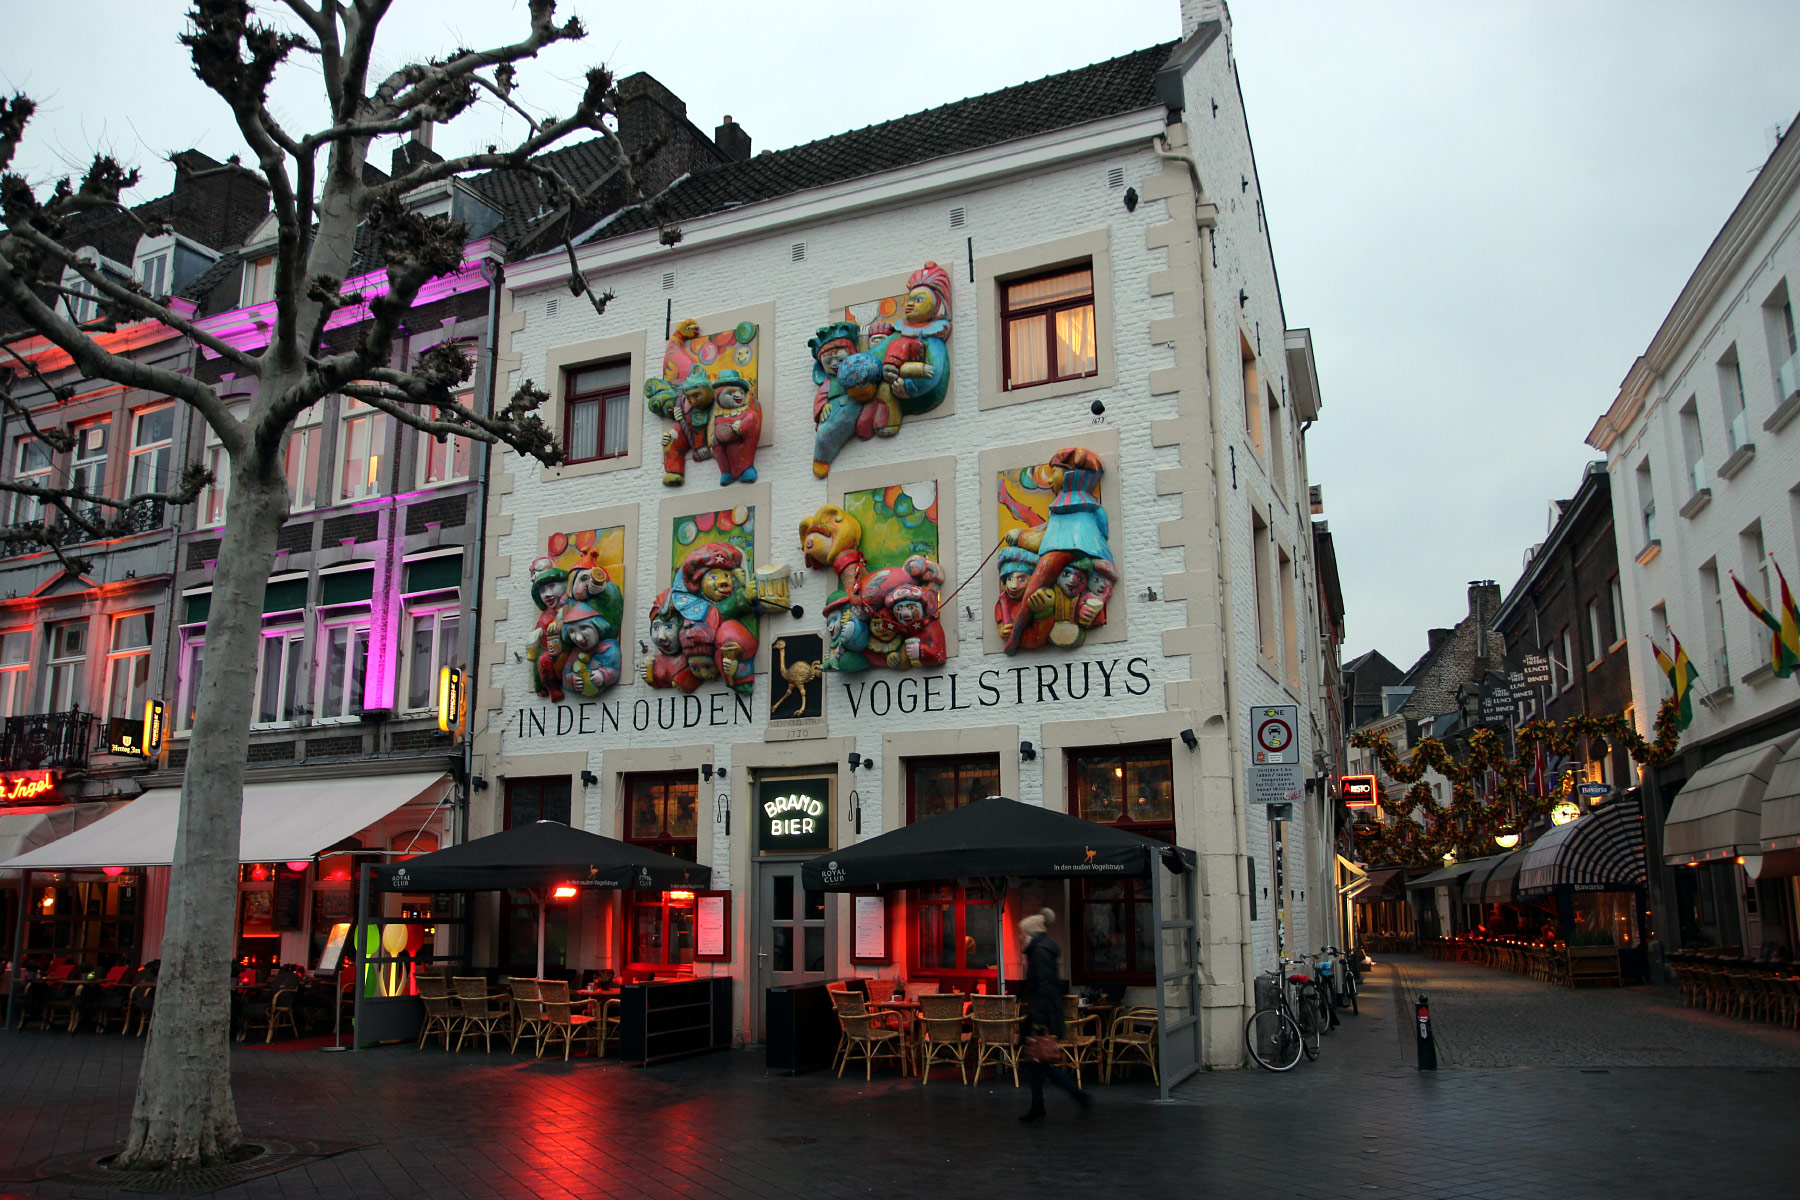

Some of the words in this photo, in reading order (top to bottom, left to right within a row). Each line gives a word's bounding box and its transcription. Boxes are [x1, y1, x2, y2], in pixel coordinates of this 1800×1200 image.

[1524, 665, 1549, 673] LUNCH
[1527, 675, 1549, 683] DINER
[843, 658, 1151, 718] VOGELSTRUYS
[1513, 690, 1533, 698] DINER
[518, 706, 546, 738] IN
[556, 701, 619, 736] DEN
[633, 692, 753, 731] OUDEN
[111, 744, 130, 754] Hertog
[7, 772, 53, 799] Ingel
[764, 794, 822, 818] BRAND
[771, 818, 814, 836] BIER
[1091, 863, 1124, 871] Vogelstruys
[821, 869, 846, 877] ROYAL
[824, 875, 845, 883] CLUB
